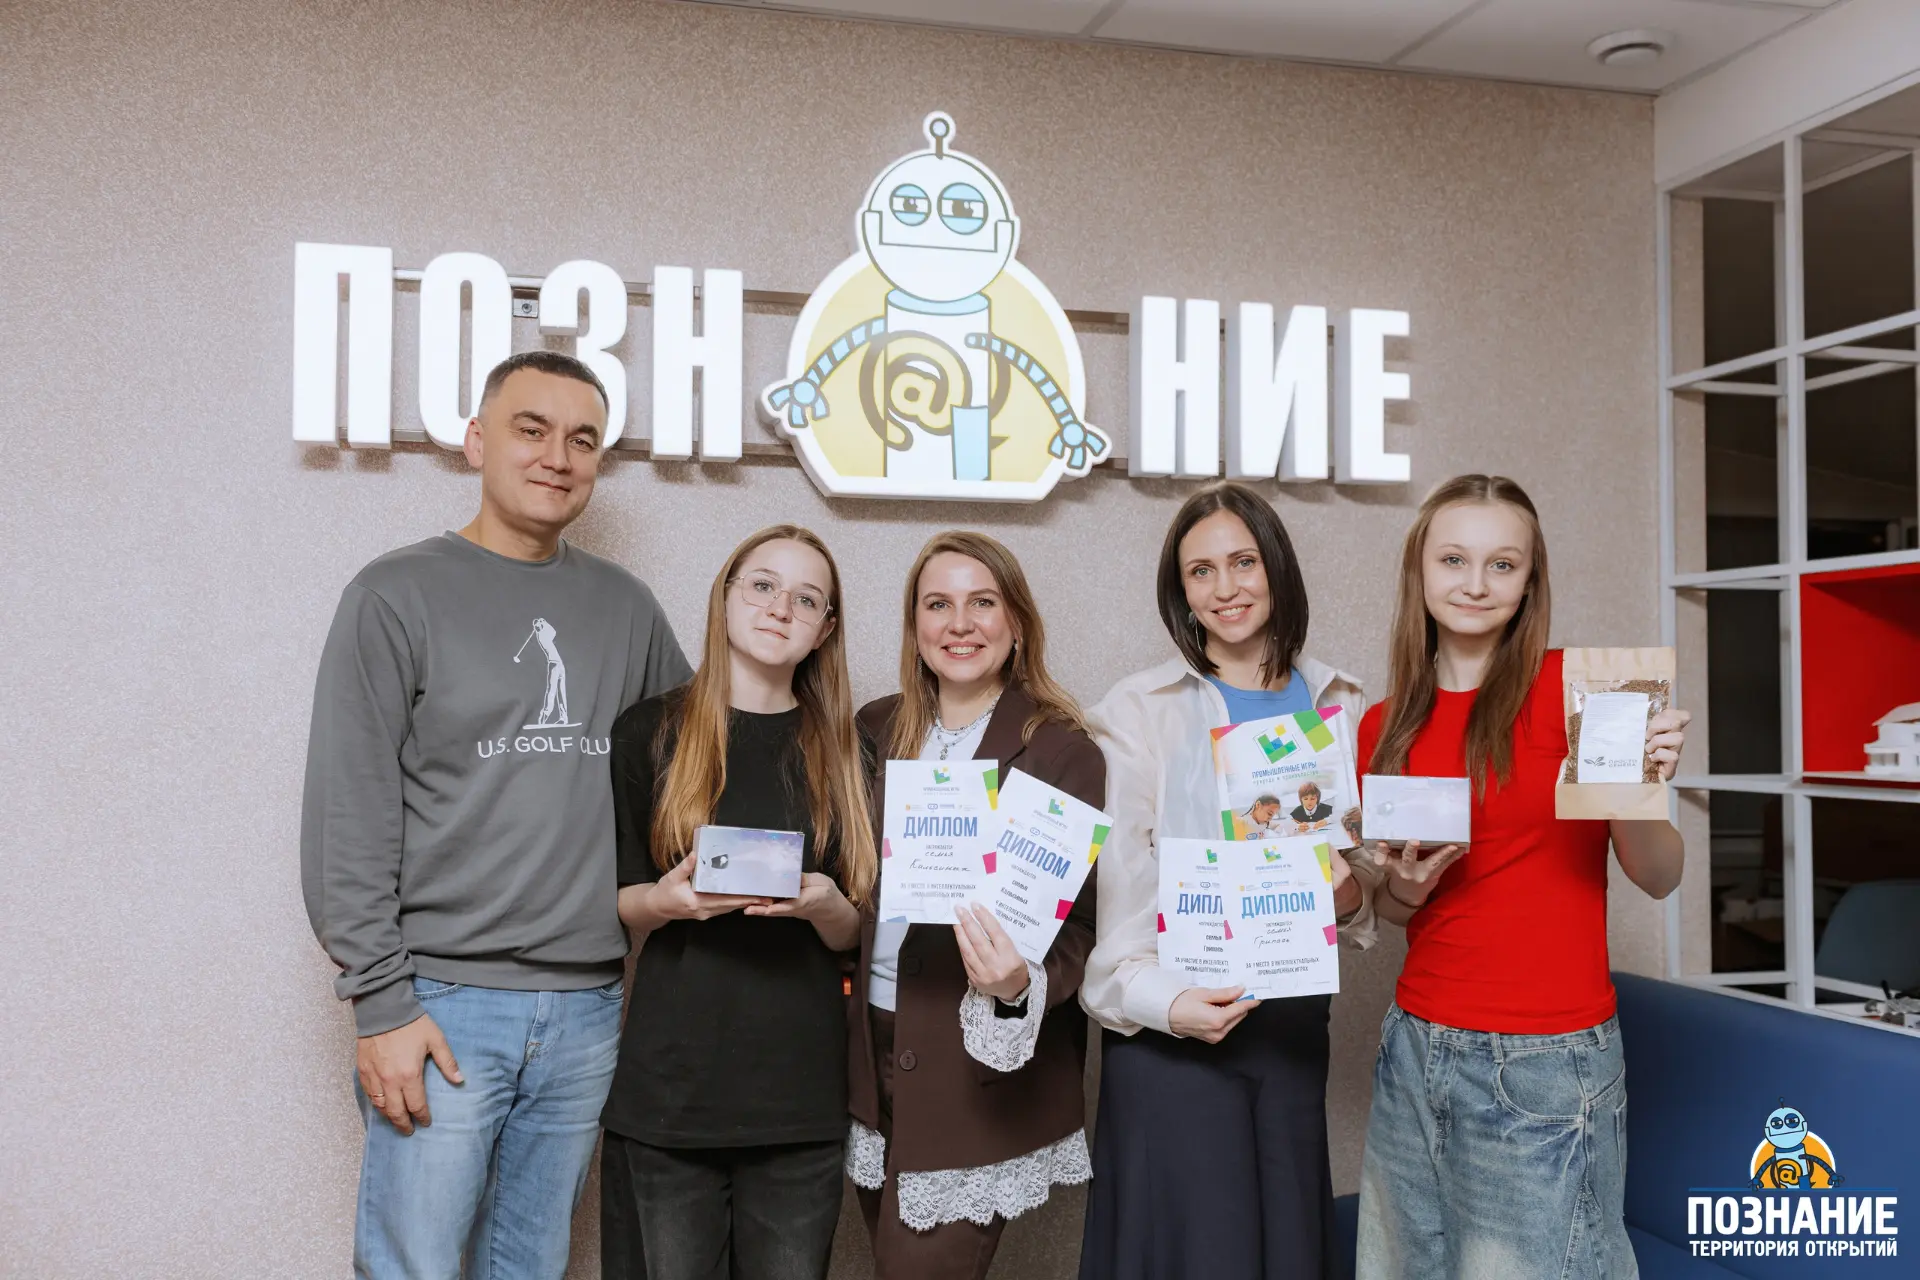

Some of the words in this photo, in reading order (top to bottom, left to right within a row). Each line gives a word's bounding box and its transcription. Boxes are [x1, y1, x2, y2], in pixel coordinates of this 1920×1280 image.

[1129, 295, 1411, 484] НИЕ
[477, 737, 510, 758] U.S.
[514, 736, 573, 753] GOLF
[580, 736, 611, 755] CLU
[903, 816, 978, 839] ДИПЛОМ
[996, 829, 1071, 880] ДИПЛОМ
[1177, 893, 1223, 915] ДИПЛ
[1241, 891, 1315, 919] ДИПЛОМ
